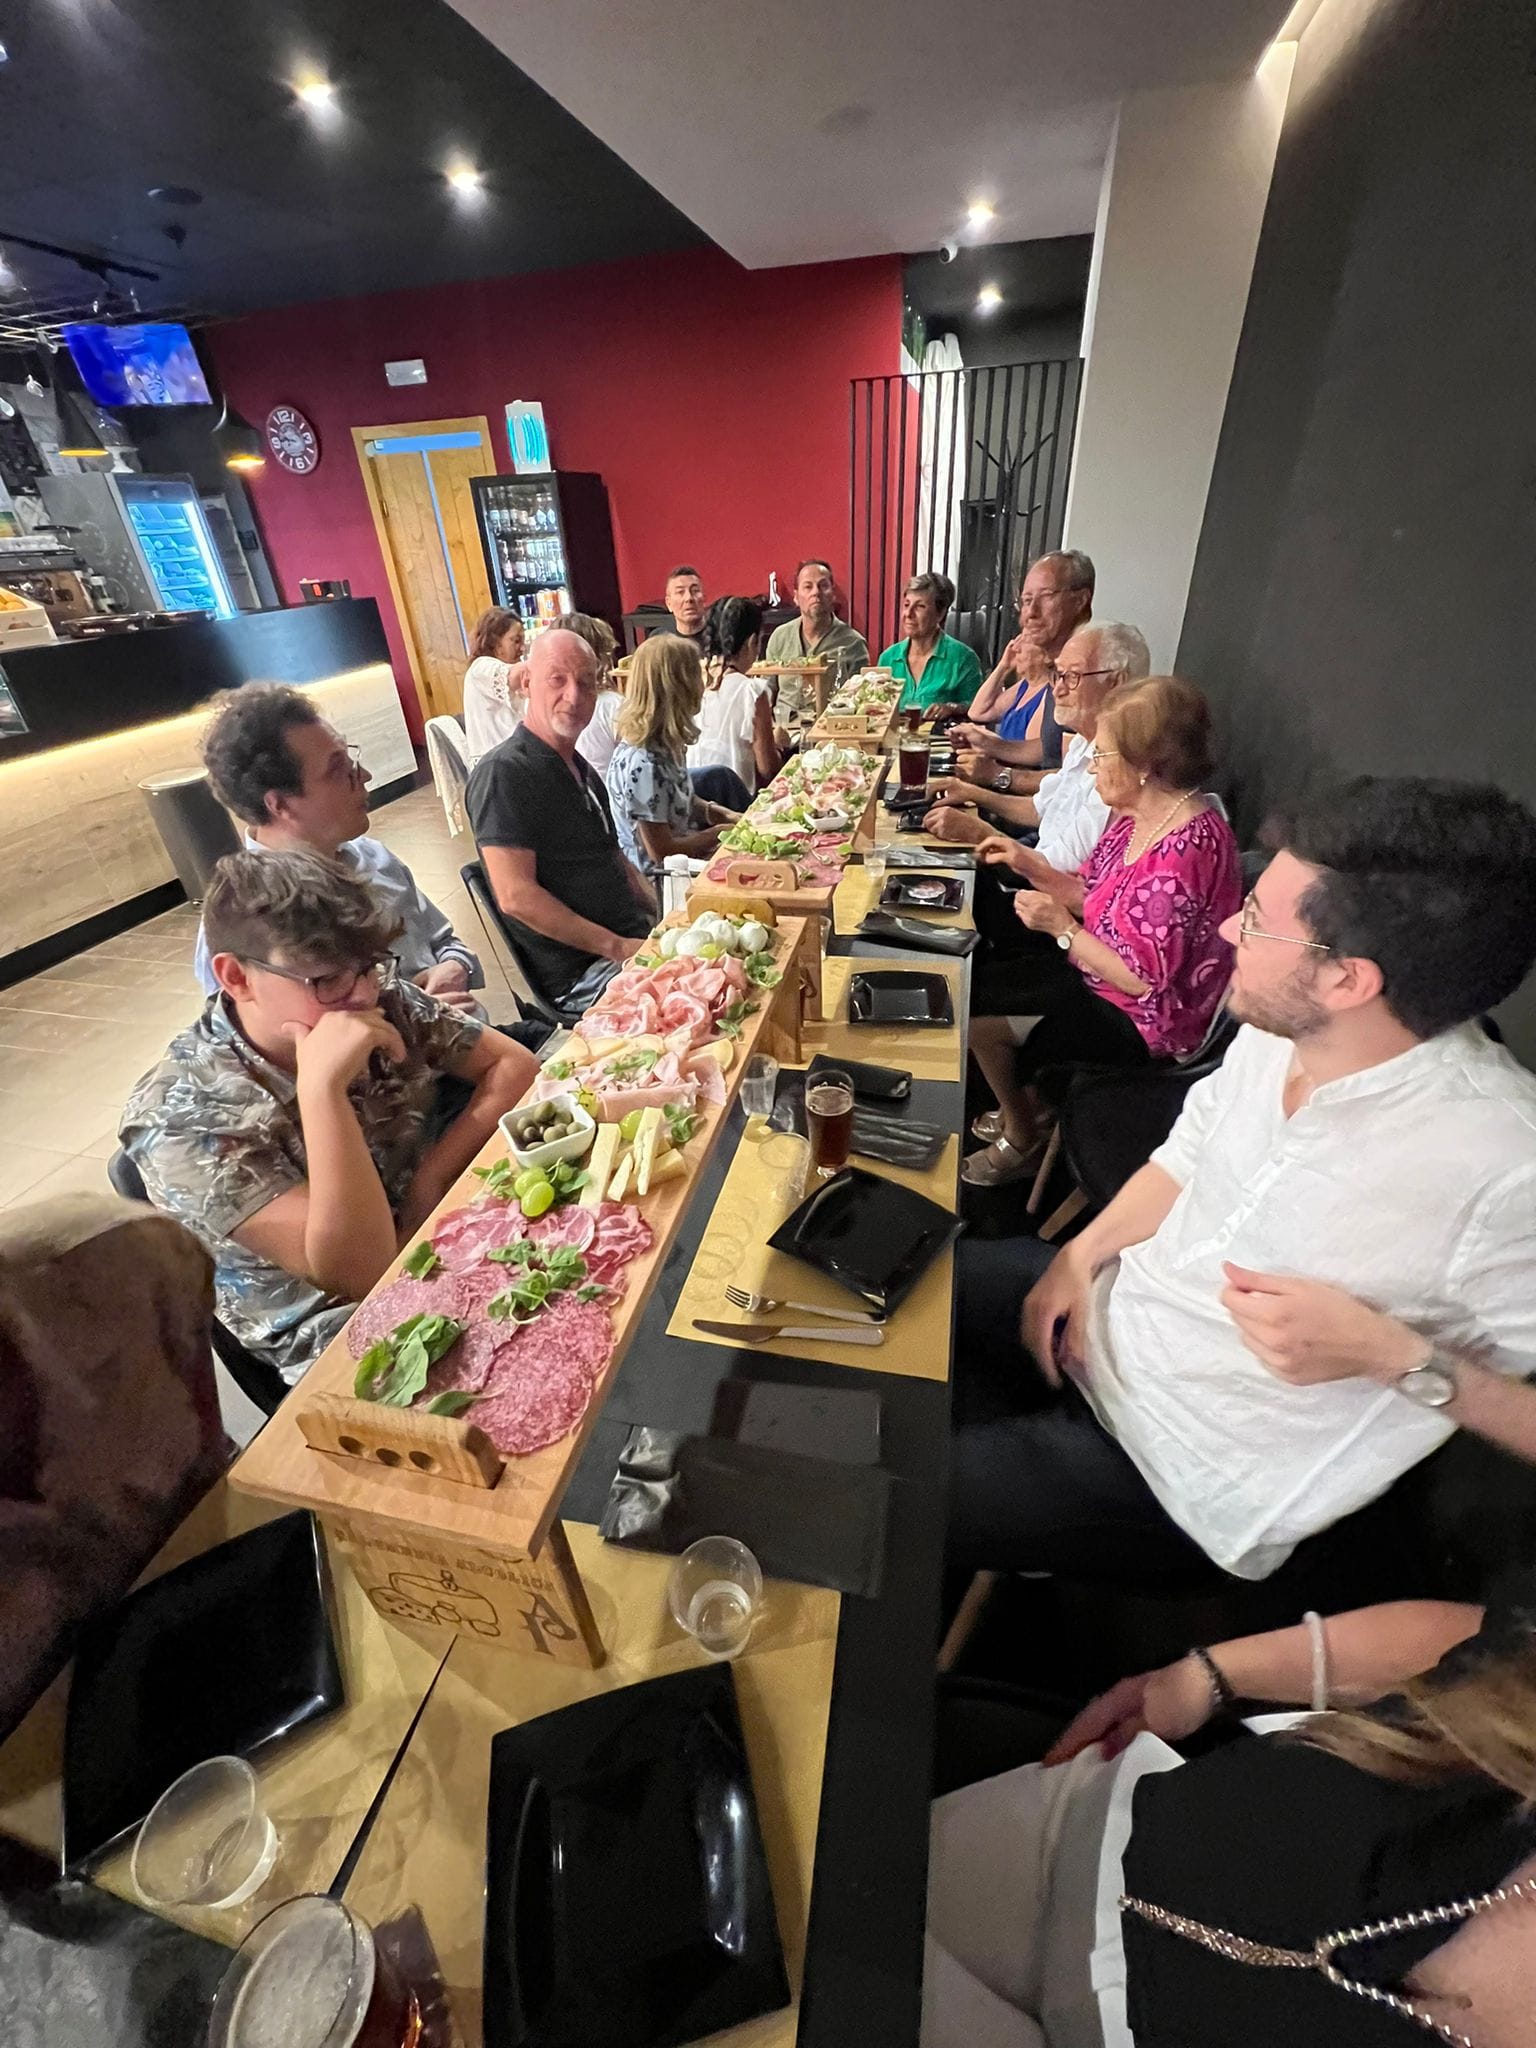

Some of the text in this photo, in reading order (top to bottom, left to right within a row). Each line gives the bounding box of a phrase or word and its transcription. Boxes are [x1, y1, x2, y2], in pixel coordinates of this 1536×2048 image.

[271, 437, 282, 449] 9
[302, 432, 313, 444] 3
[295, 457, 305, 469] 6
